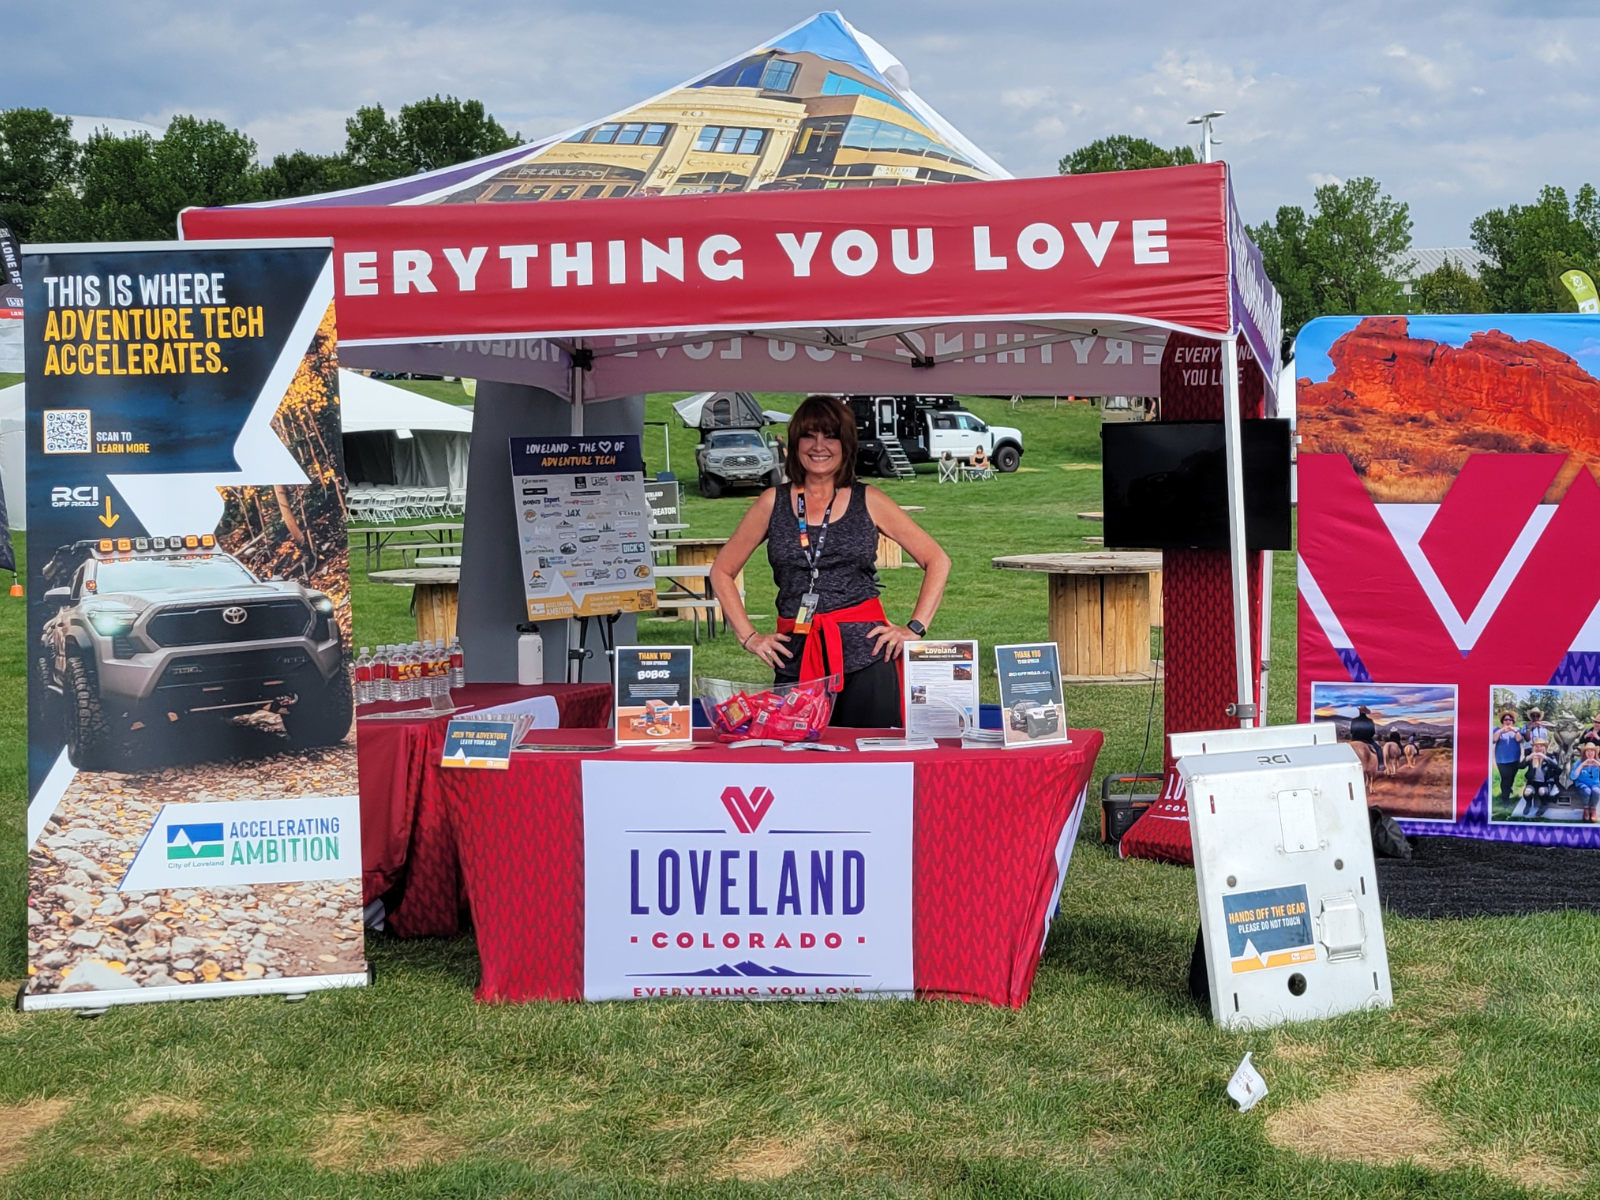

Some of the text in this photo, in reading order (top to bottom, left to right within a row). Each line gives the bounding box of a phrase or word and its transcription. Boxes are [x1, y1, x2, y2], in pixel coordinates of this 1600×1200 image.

[519, 168, 605, 177] RIALTO
[1, 241, 17, 268] LONE
[344, 219, 1169, 297] ERYTHING YOU LOVE
[44, 273, 226, 307] THIS IS WHERE
[44, 306, 264, 342] ADVENTURE TECH
[44, 342, 229, 376] ACCELERATES.
[1182, 367, 1244, 387] YOU LE
[96, 431, 132, 442] SCAN TO
[96, 443, 150, 454] LEARN MORE
[526, 443, 569, 454] LOVELAND
[579, 442, 597, 453] THE
[614, 441, 625, 452] OF
[541, 455, 616, 467] ADVENTURE TECH
[52, 487, 98, 501] RCI
[565, 509, 581, 517] JAX
[638, 652, 671, 660] THANK YOU
[637, 669, 671, 680] BOBO'S
[451, 731, 508, 740] JOIN THE ADVENTURE
[1257, 754, 1292, 765] RCI
[230, 817, 340, 839] ACCELERATING
[230, 836, 340, 866] AMBITION
[167, 862, 182, 870] City
[192, 860, 224, 868] Loveland
[630, 848, 866, 916] LOVELAND
[1228, 902, 1306, 925] HANDS OFF THE GEAR
[1238, 916, 1301, 934] PLEASE DO NOT TOUCH
[651, 932, 843, 949] COLORADO
[633, 986, 863, 998] EVERYTHING YOU LOVE
